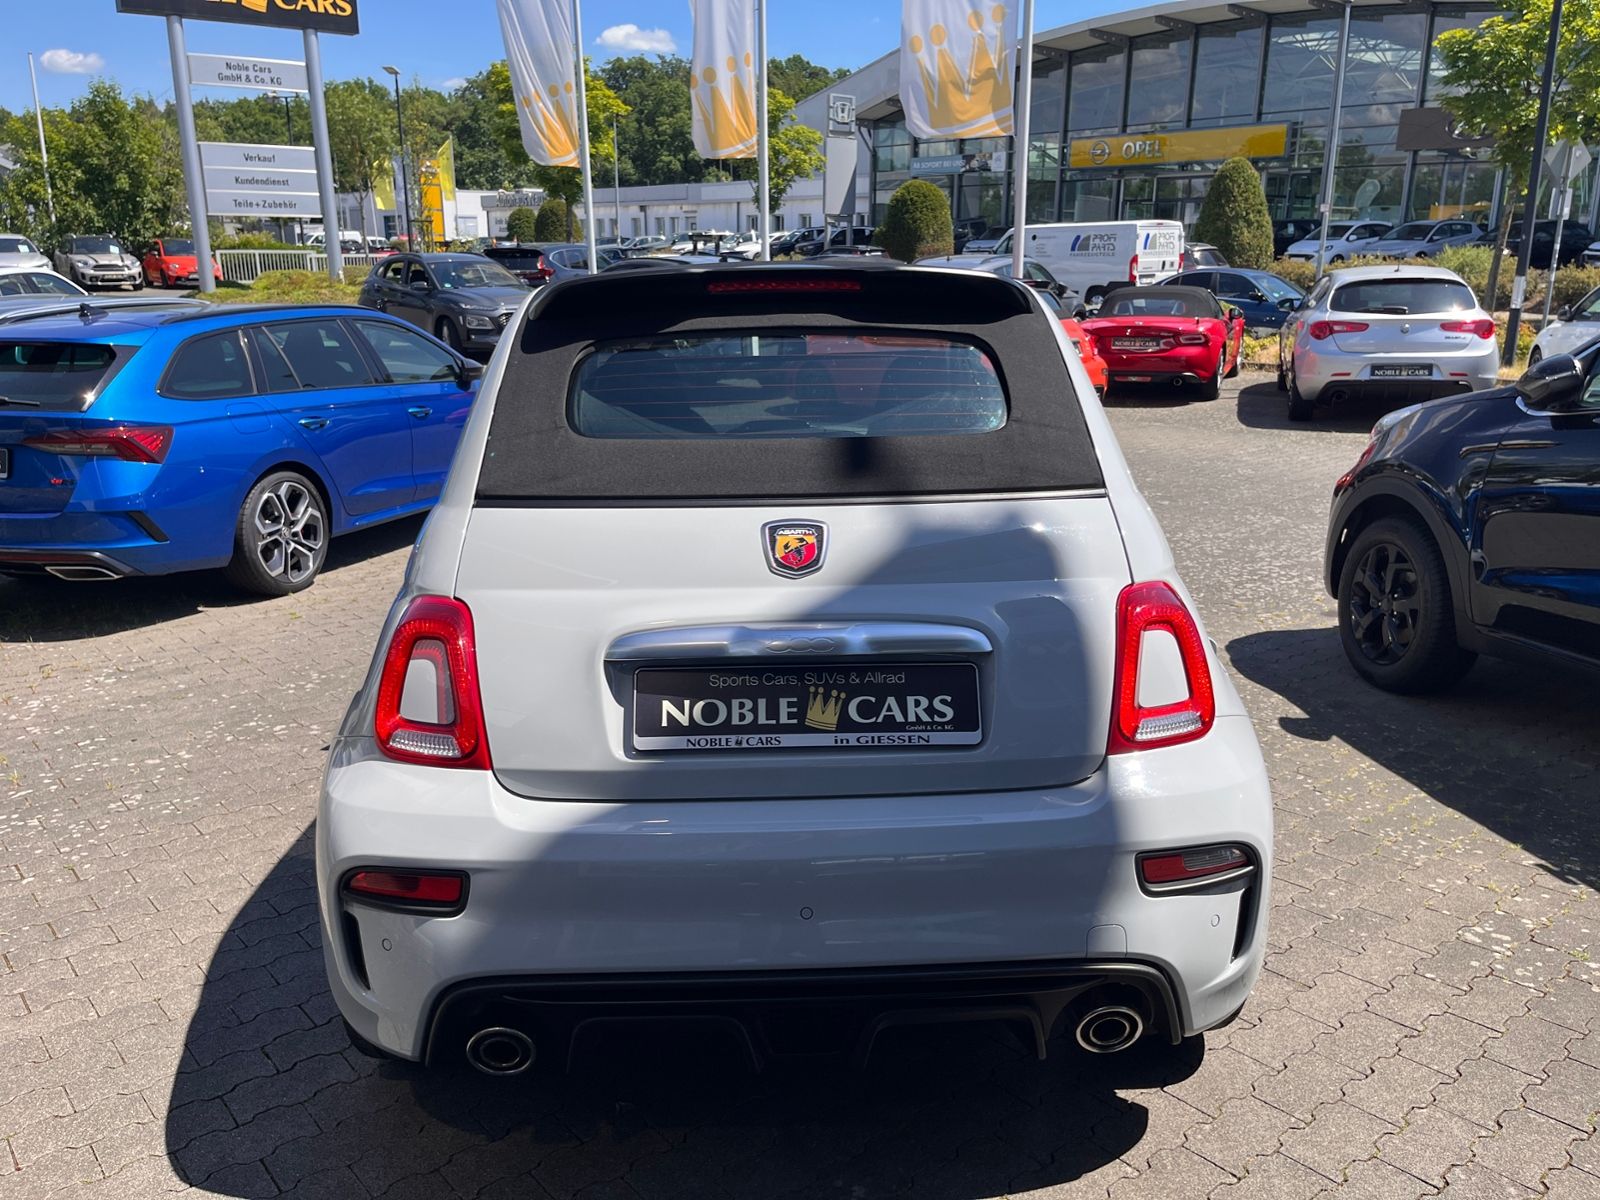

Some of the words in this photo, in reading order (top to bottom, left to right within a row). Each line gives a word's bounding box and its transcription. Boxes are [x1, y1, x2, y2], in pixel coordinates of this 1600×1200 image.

[225, 62, 250, 72] Noble
[252, 64, 272, 74] Cars
[217, 72, 242, 82] GmbH
[244, 74, 252, 83] &
[254, 75, 268, 84] Co.
[270, 76, 282, 86] KG
[1122, 139, 1162, 159] OPEL
[243, 152, 276, 163] Verkauf
[234, 175, 290, 187] Kundendienst
[709, 674, 759, 688] Sports
[762, 673, 801, 687] Cars,
[804, 671, 845, 685] SUVs
[849, 671, 861, 684] &
[864, 671, 905, 684] Allrad
[661, 697, 798, 727] NOBLE
[847, 695, 955, 724] CARS
[686, 737, 733, 748] NOBLE
[745, 735, 782, 746] CARS
[834, 736, 850, 745] in
[856, 735, 931, 745] GIESSEN
